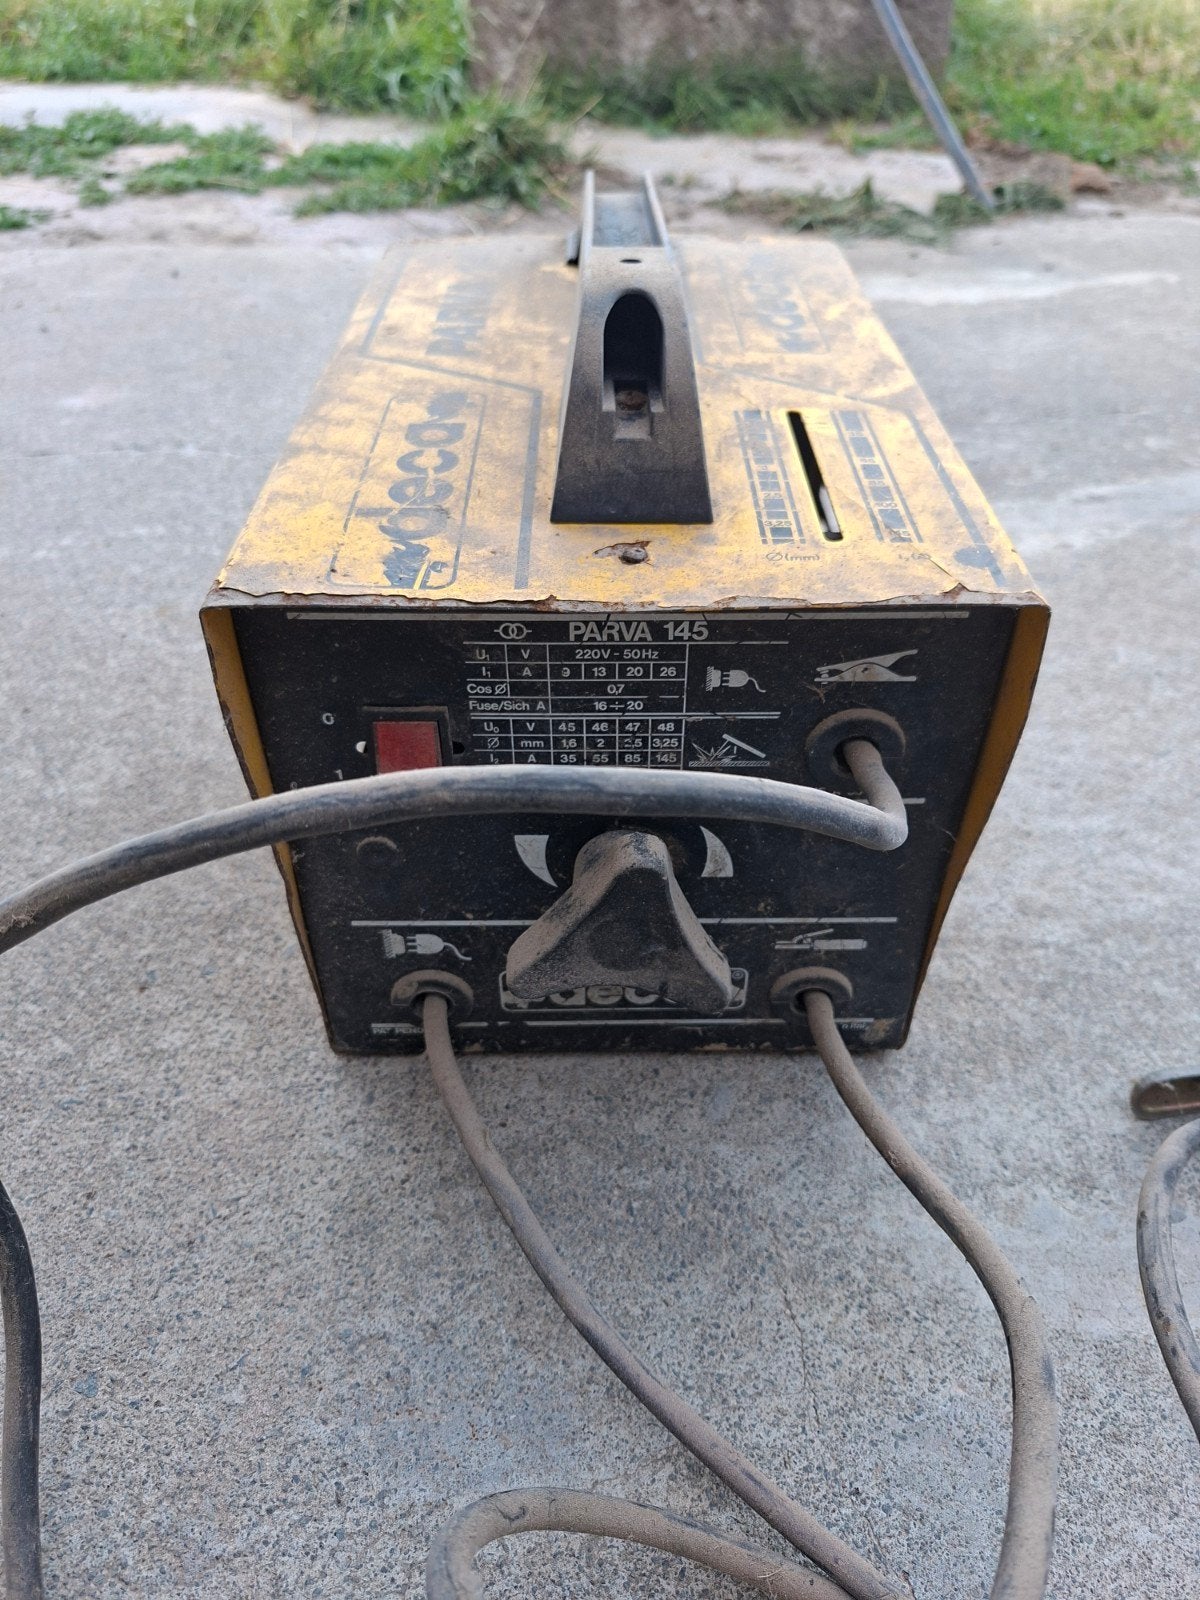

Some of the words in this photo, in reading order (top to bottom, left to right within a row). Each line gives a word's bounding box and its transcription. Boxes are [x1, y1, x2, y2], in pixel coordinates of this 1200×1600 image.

[764, 520, 793, 528] 3,25
[568, 621, 653, 642] PARVA
[663, 621, 709, 641] 145
[521, 649, 531, 661] V
[575, 648, 611, 660] 220V
[522, 667, 533, 677] A
[592, 666, 607, 677] 13
[626, 666, 644, 677] 20
[660, 666, 677, 677] 26
[466, 683, 493, 694] Cos
[607, 684, 626, 695] 0,7
[468, 699, 530, 711] Fuse/Sich
[535, 700, 546, 711] A
[526, 722, 536, 731] V
[558, 722, 576, 732] 45
[592, 722, 609, 732] 46
[625, 722, 641, 732] 47
[657, 722, 675, 732] 48
[520, 740, 544, 748] mm
[561, 738, 578, 749] 1,6
[596, 738, 605, 748] 2
[624, 738, 642, 749] 2,5
[652, 738, 679, 749] 3,25
[527, 754, 537, 763] A
[560, 754, 577, 764] 35
[593, 754, 609, 763] 55
[624, 754, 641, 763] 85
[655, 754, 677, 763] 145
